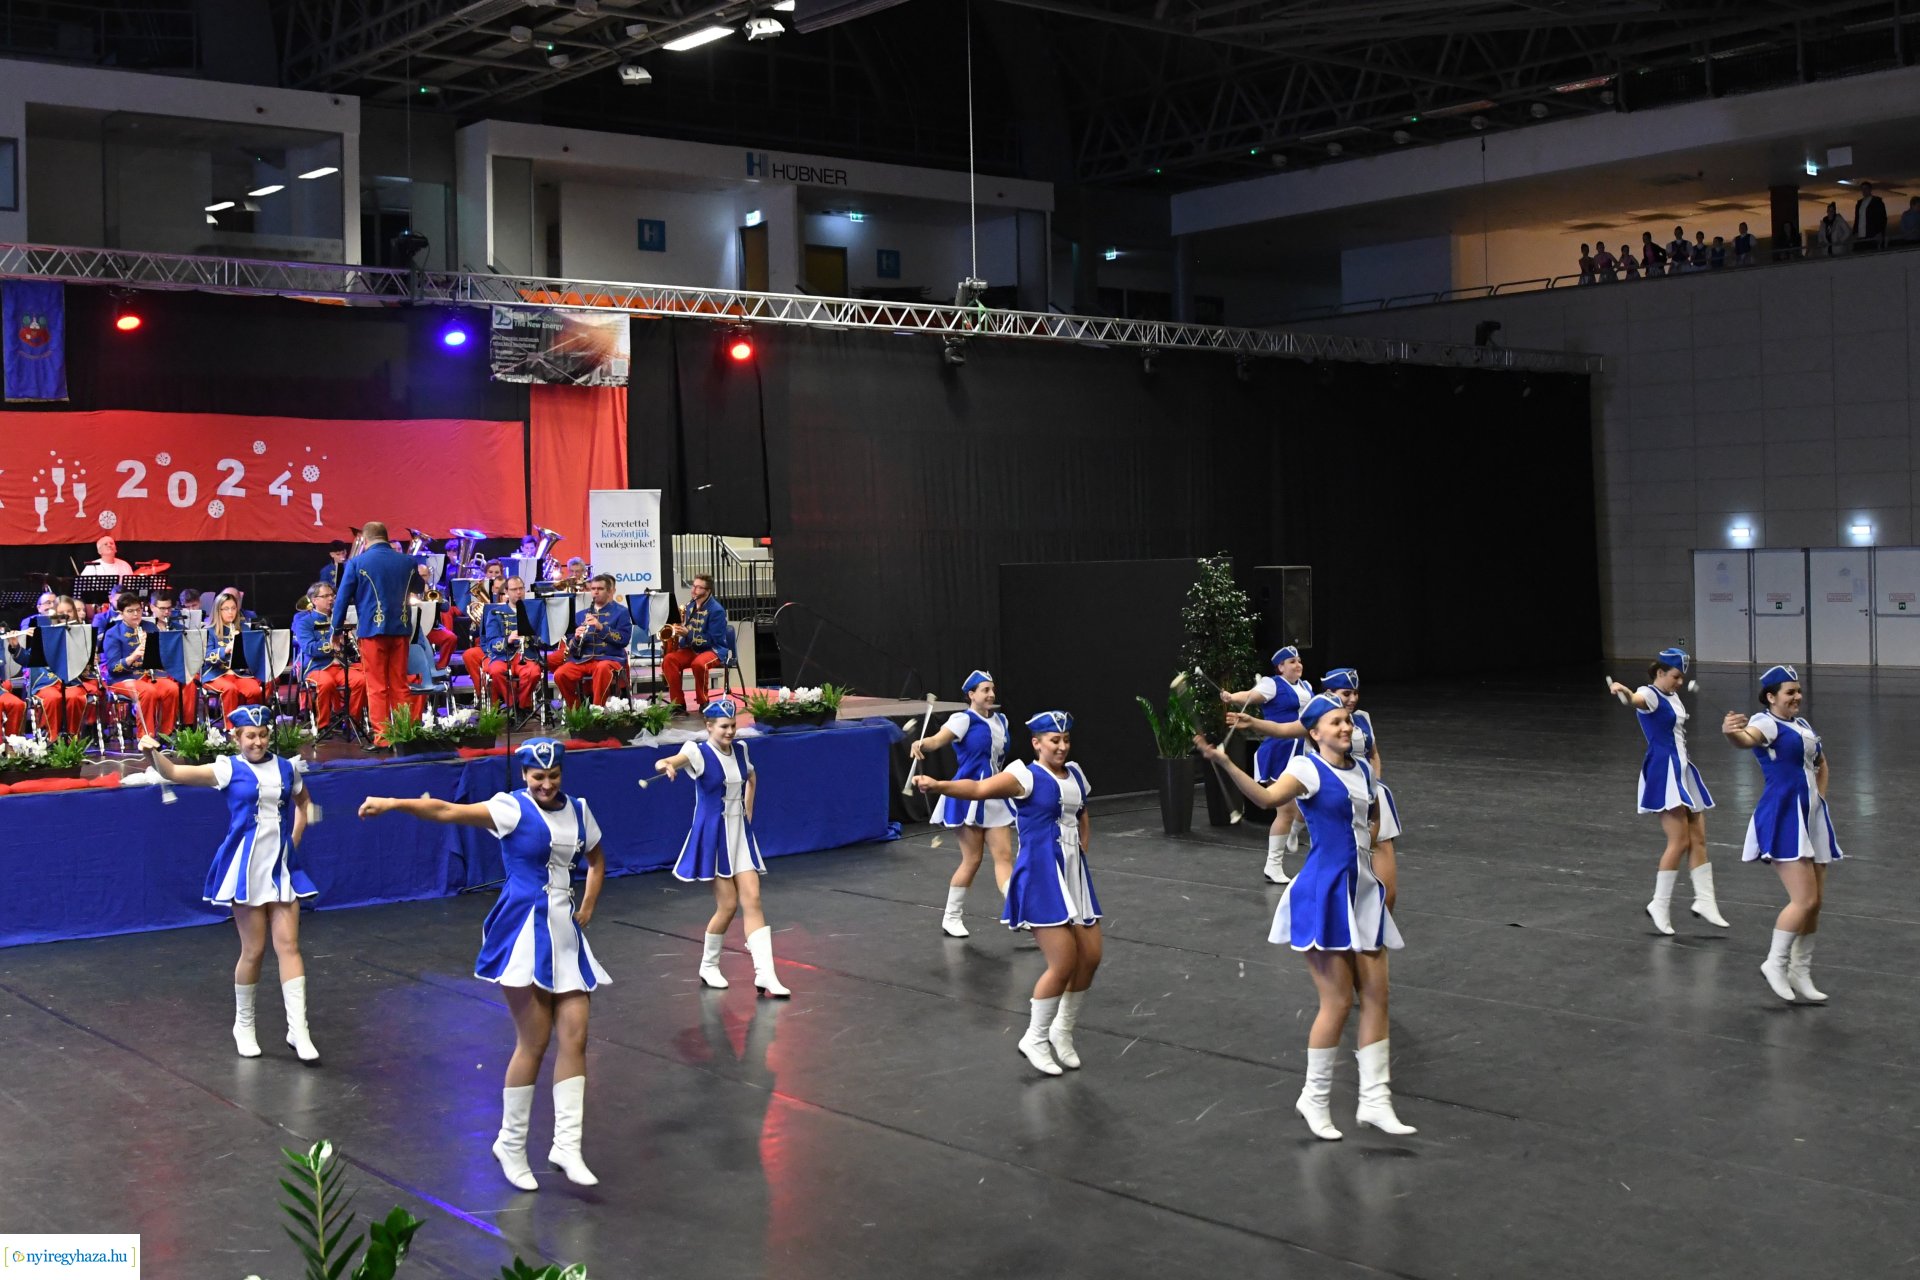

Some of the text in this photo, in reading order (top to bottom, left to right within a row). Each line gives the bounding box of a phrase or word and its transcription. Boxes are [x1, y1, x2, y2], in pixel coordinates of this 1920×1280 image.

[772, 163, 848, 186] HÜBNER
[514, 320, 564, 331] The New Energy
[116, 458, 294, 508] 2024
[601, 519, 649, 528] Szeretettel
[601, 529, 650, 539] köszöntjük
[595, 539, 656, 550] vendégeinket!
[616, 572, 652, 582] SALDO
